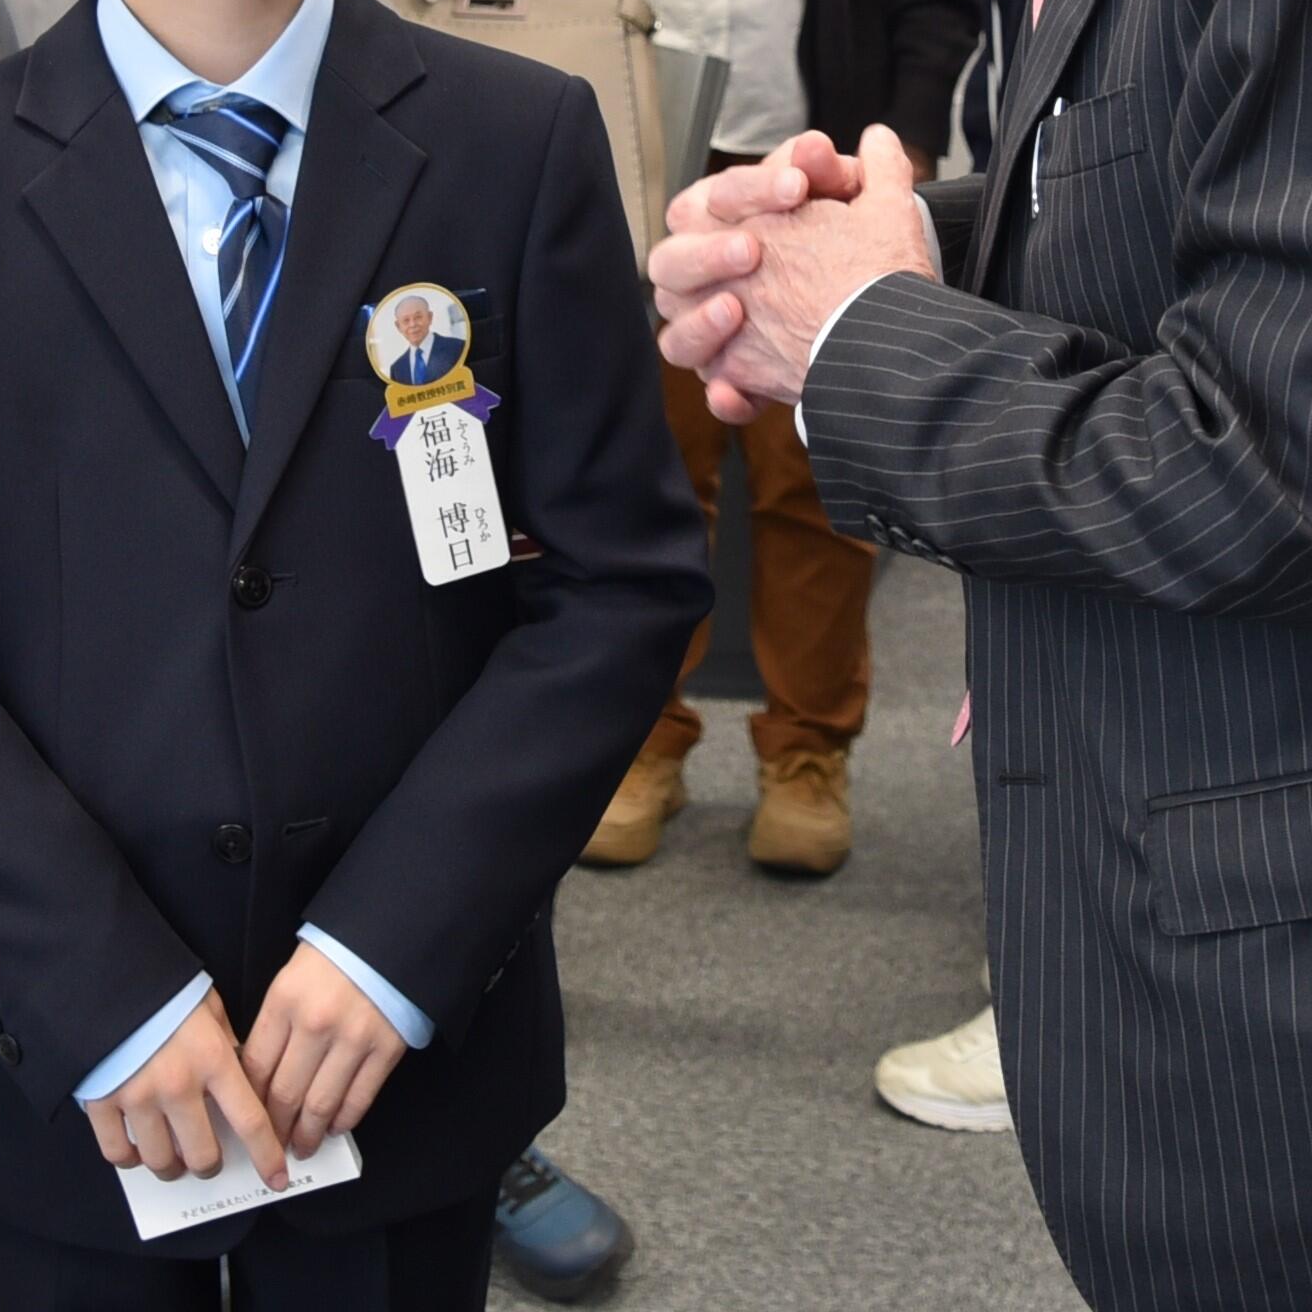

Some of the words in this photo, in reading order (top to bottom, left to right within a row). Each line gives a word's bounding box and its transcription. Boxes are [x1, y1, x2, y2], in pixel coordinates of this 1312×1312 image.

[417, 411, 459, 482] 福海
[456, 419, 475, 467] ふくうみ
[474, 508, 491, 542] ひろか
[437, 502, 474, 571] 博日
